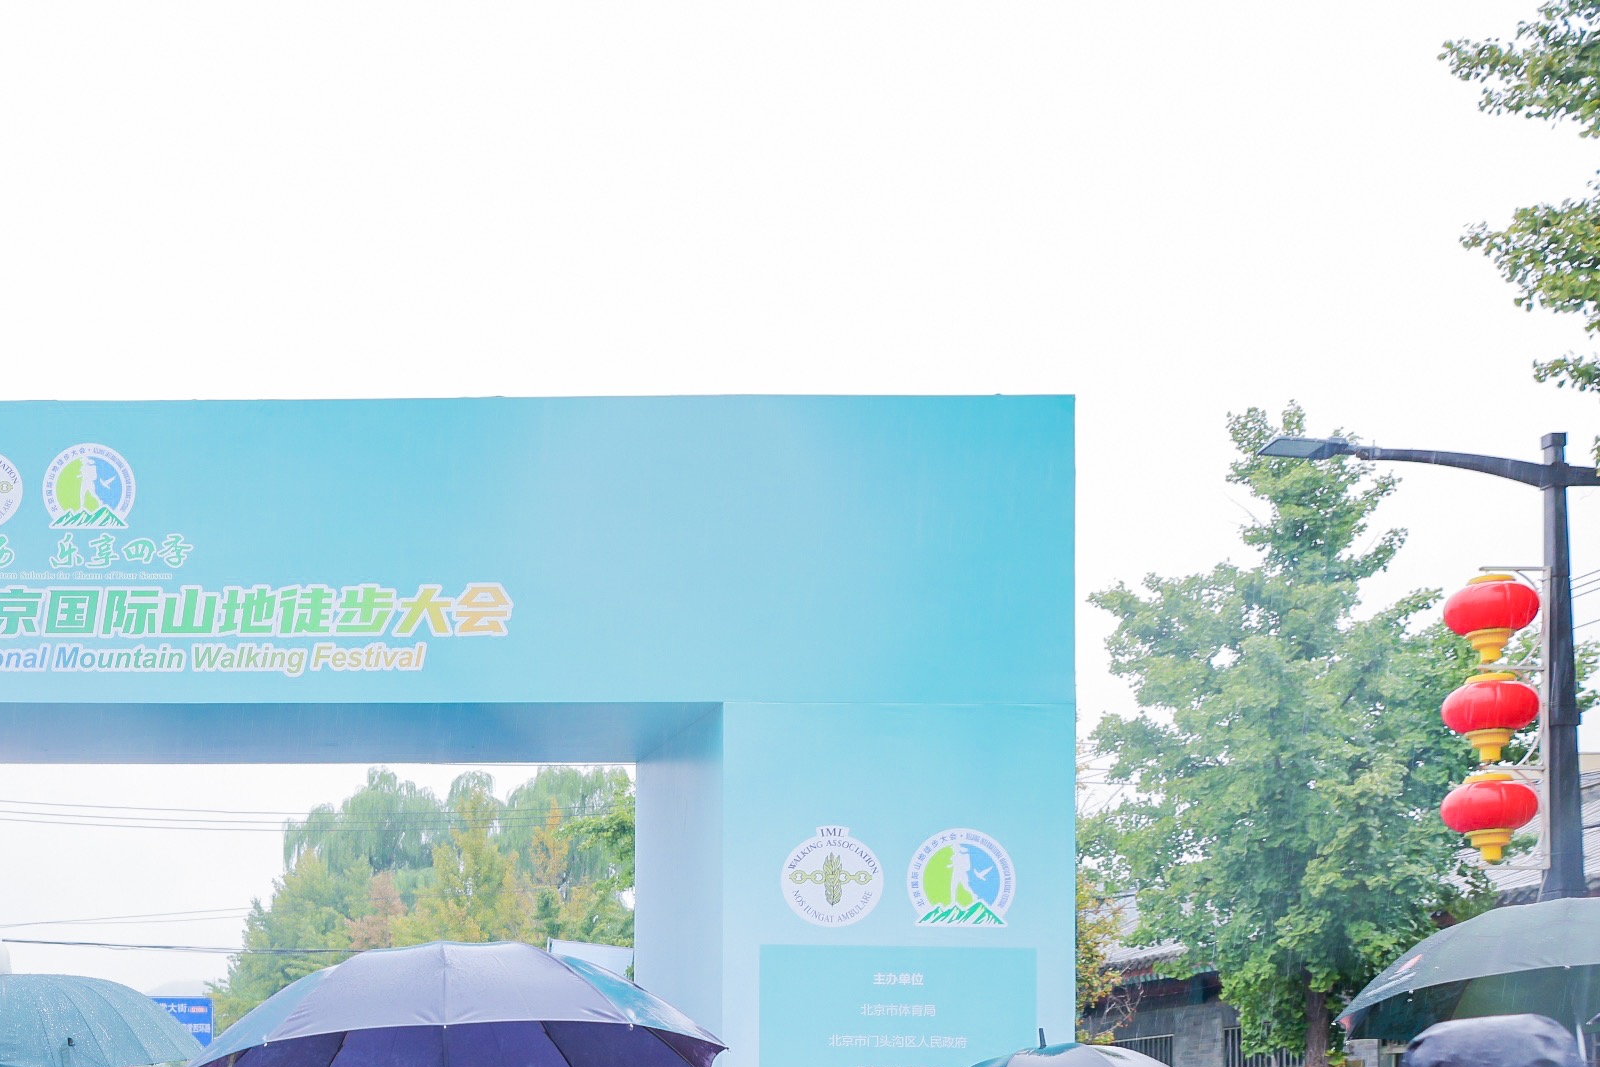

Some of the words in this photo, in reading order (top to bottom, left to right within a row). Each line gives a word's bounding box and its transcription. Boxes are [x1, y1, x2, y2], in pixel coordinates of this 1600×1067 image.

[51, 533, 192, 568] 乐享四季
[55, 644, 184, 669] Mountain
[193, 644, 304, 674] Walking
[312, 644, 423, 669] Festival
[820, 827, 845, 837] IML
[788, 840, 823, 870] WALKING
[826, 839, 880, 875] ASSOCIATION
[837, 890, 873, 923] AMBULARE
[872, 972, 924, 986] 主办单位
[860, 1003, 936, 1017] 北京市体育局
[828, 1034, 968, 1049] 北京市门头沟区人民政府
